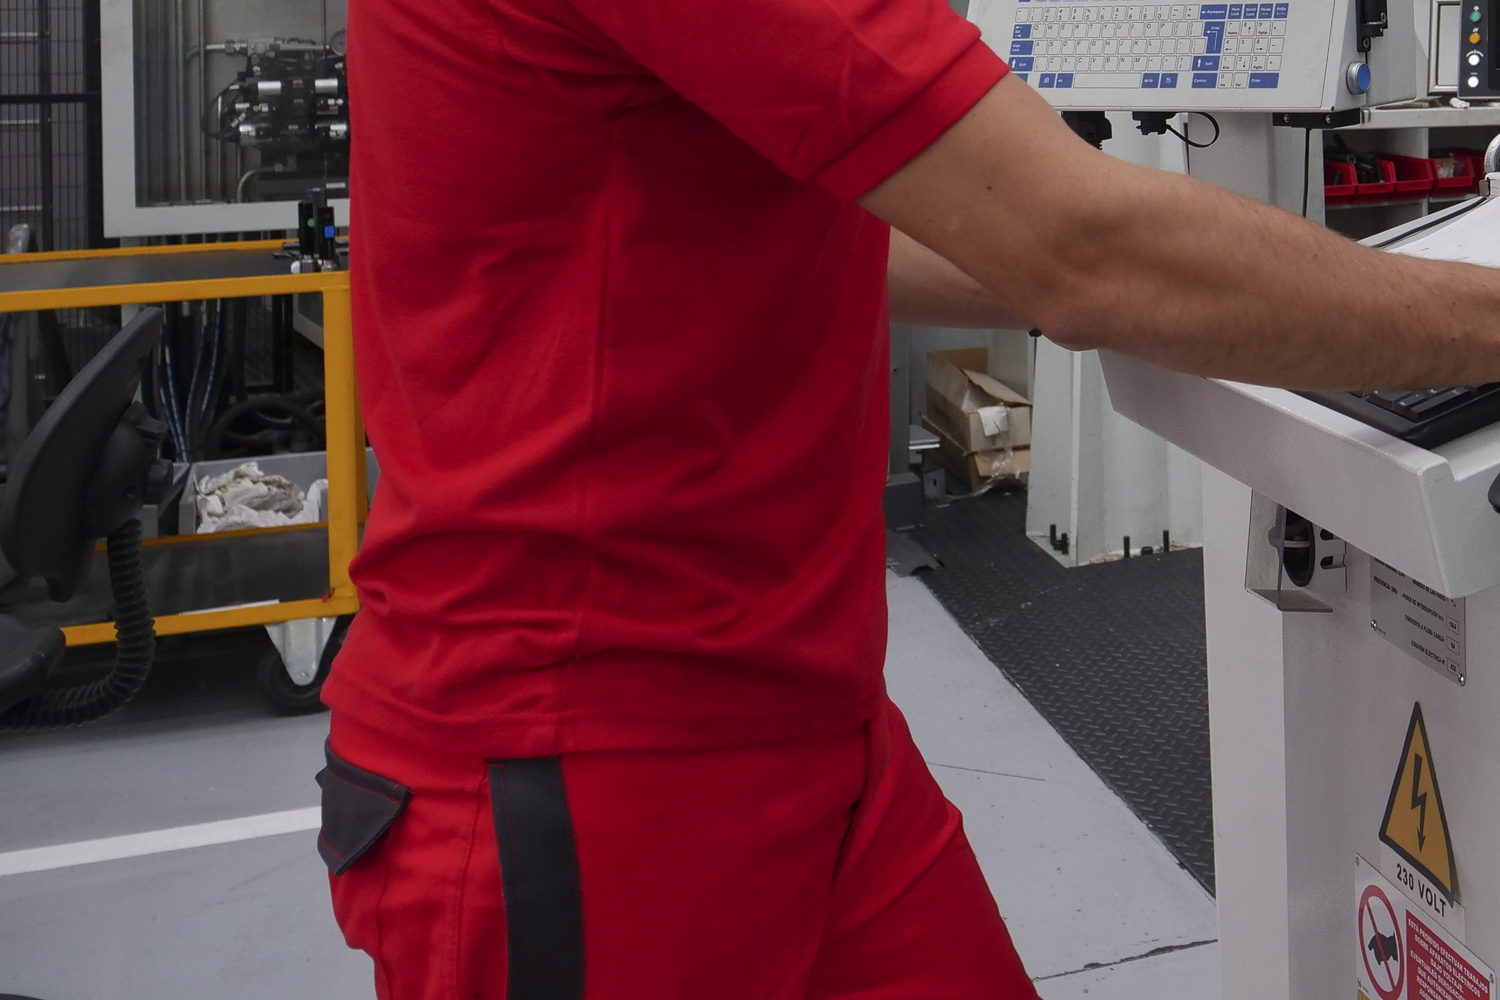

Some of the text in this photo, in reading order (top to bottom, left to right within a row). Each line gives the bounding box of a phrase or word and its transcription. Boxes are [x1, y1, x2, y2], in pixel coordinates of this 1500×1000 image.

[1396, 863, 1446, 918] 230 VOLT
[1410, 950, 1438, 979] EVENTUALES
[1415, 934, 1429, 951] SOBRE
[1430, 947, 1452, 972] APARATOS
[1431, 958, 1442, 973] BAJO
[1418, 966, 1426, 979] QUE
[1440, 947, 1463, 972] EFECTUAR
[1464, 967, 1488, 994] TRABAJOS
